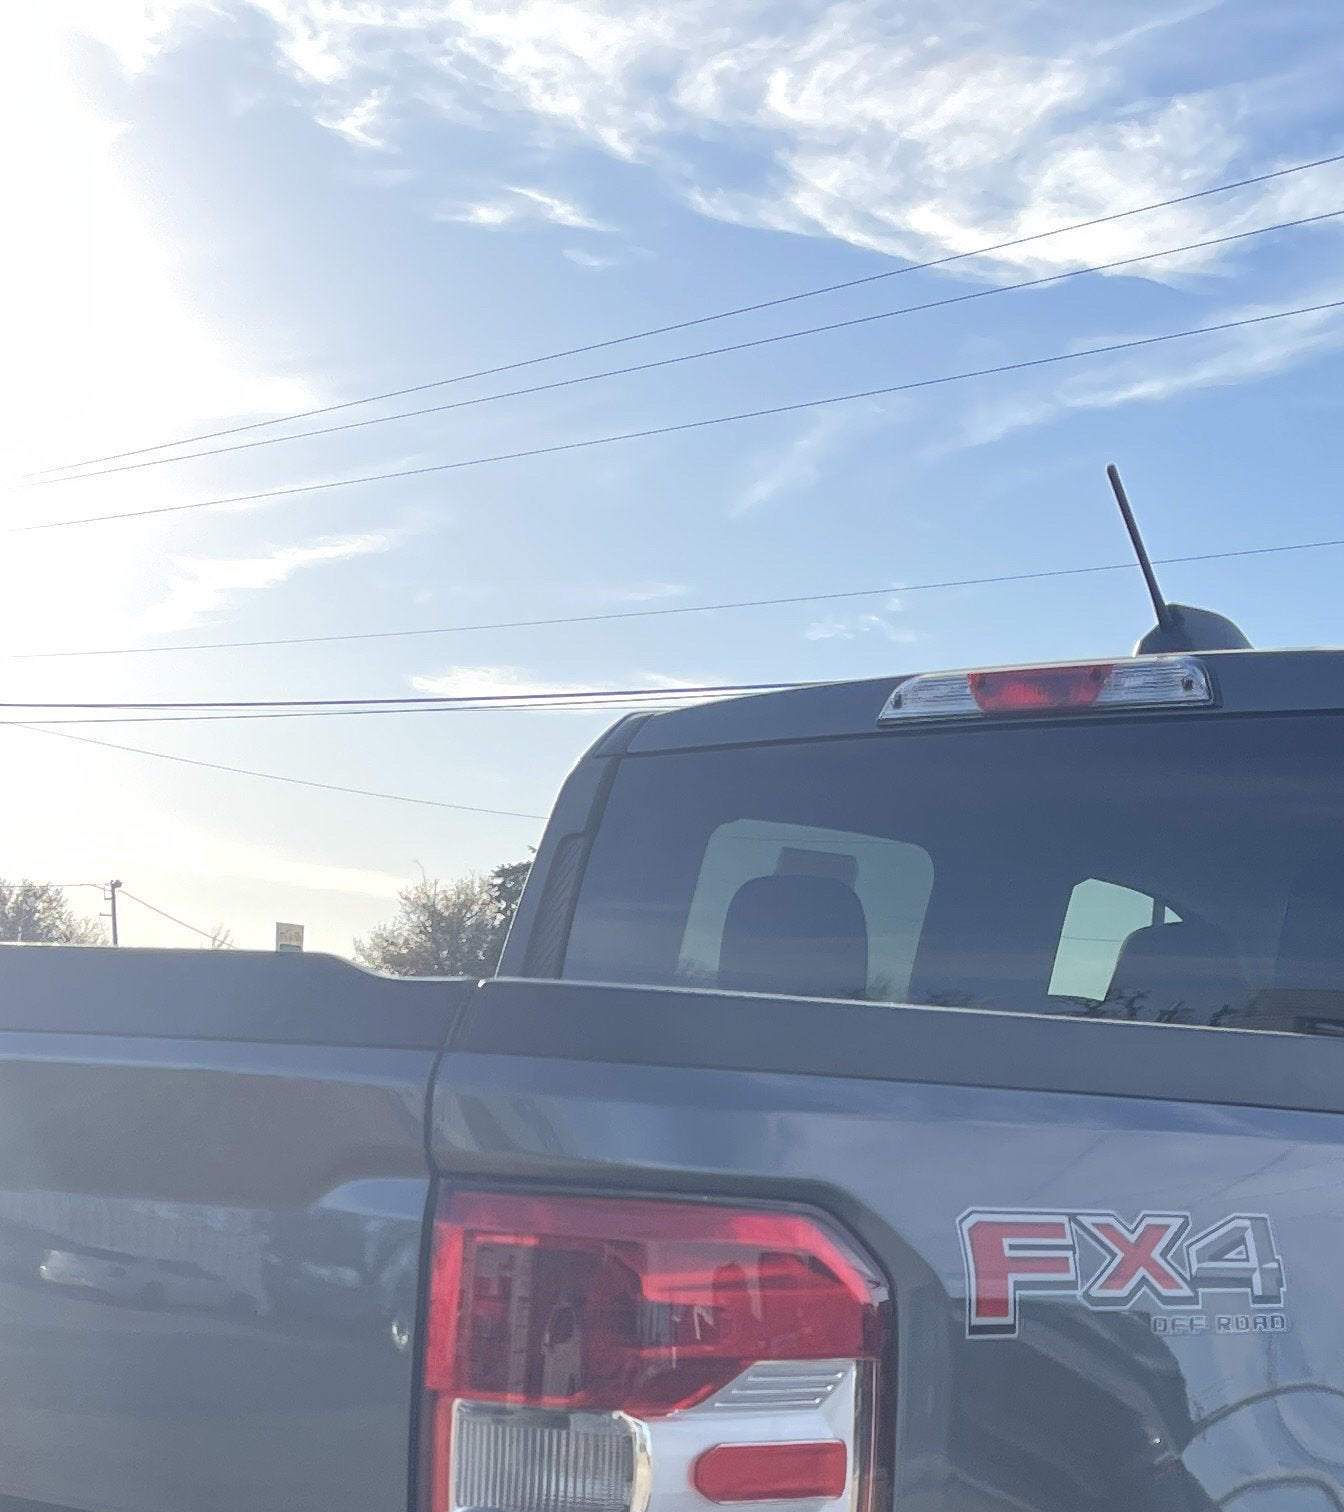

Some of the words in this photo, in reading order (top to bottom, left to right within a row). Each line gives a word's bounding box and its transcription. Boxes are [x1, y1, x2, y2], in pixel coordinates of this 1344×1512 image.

[957, 1208, 1287, 1339] FX4
[1151, 1315, 1208, 1335] OFF
[1214, 1312, 1289, 1334] ROAD
